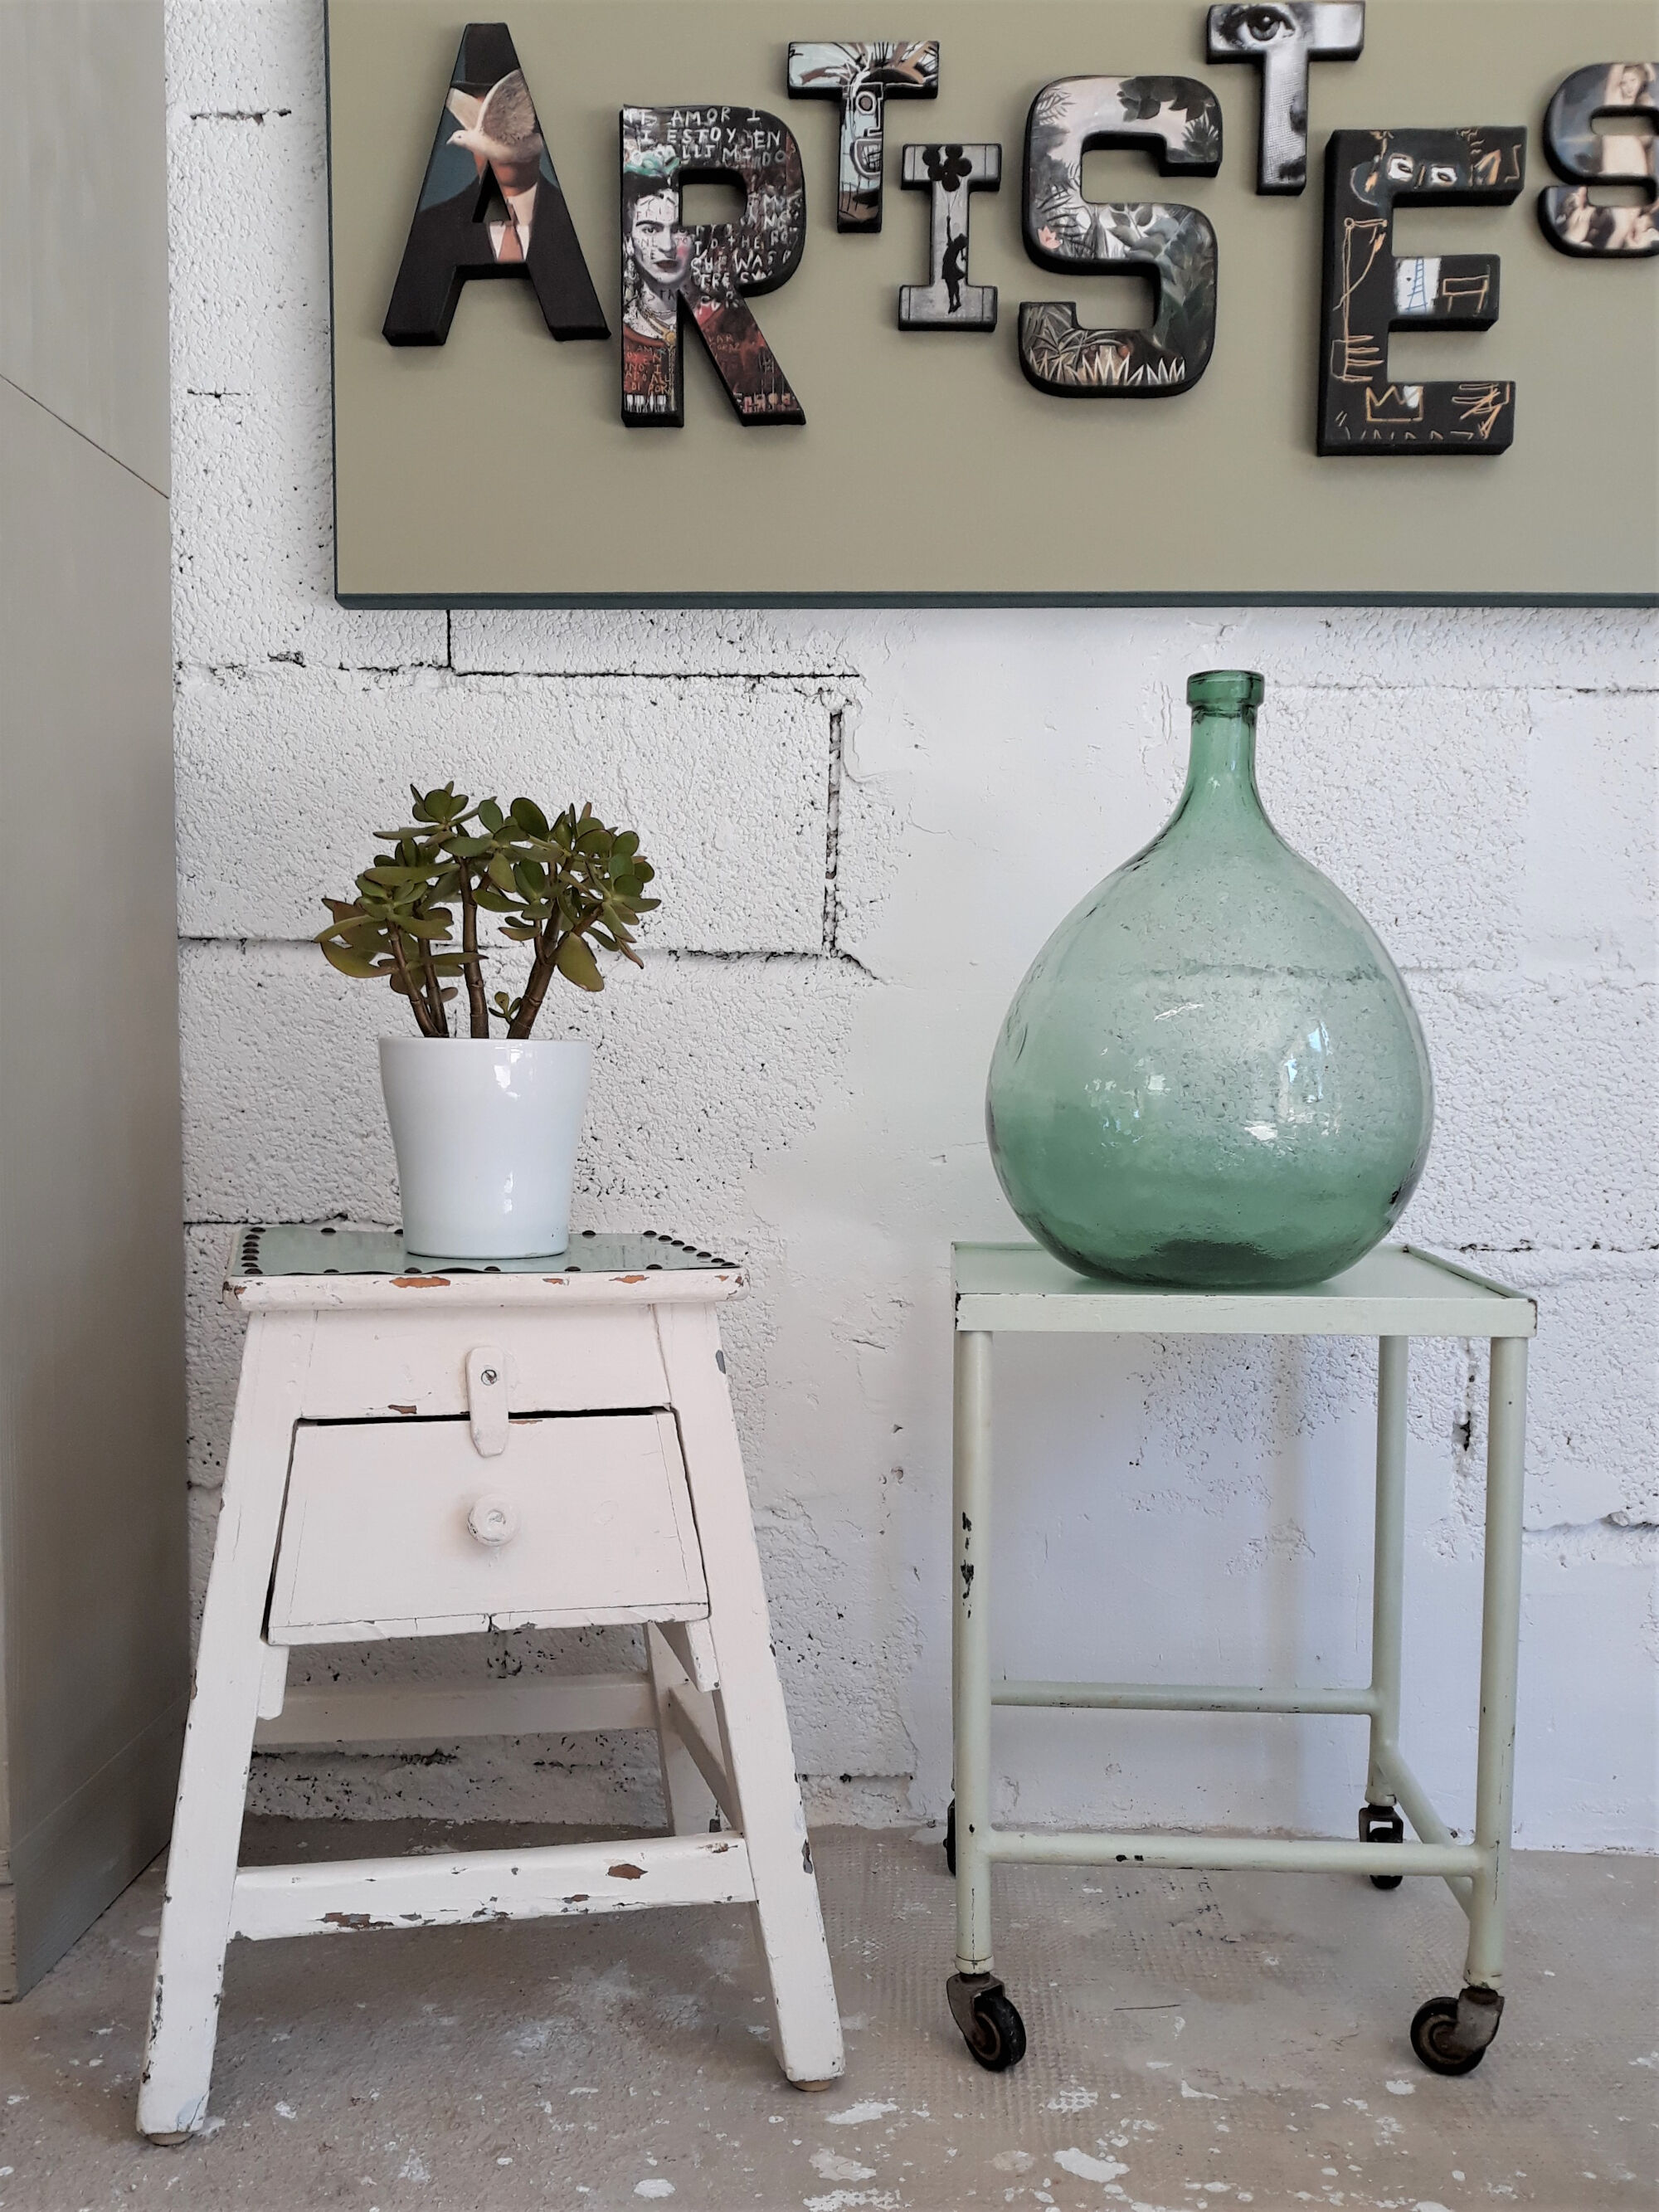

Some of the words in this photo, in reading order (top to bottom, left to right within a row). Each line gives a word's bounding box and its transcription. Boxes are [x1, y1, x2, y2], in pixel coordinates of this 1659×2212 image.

[670, 106, 732, 127] AMOR
[666, 127, 737, 144] ESTOY
[382, 2, 1659, 454] ARTISTES
